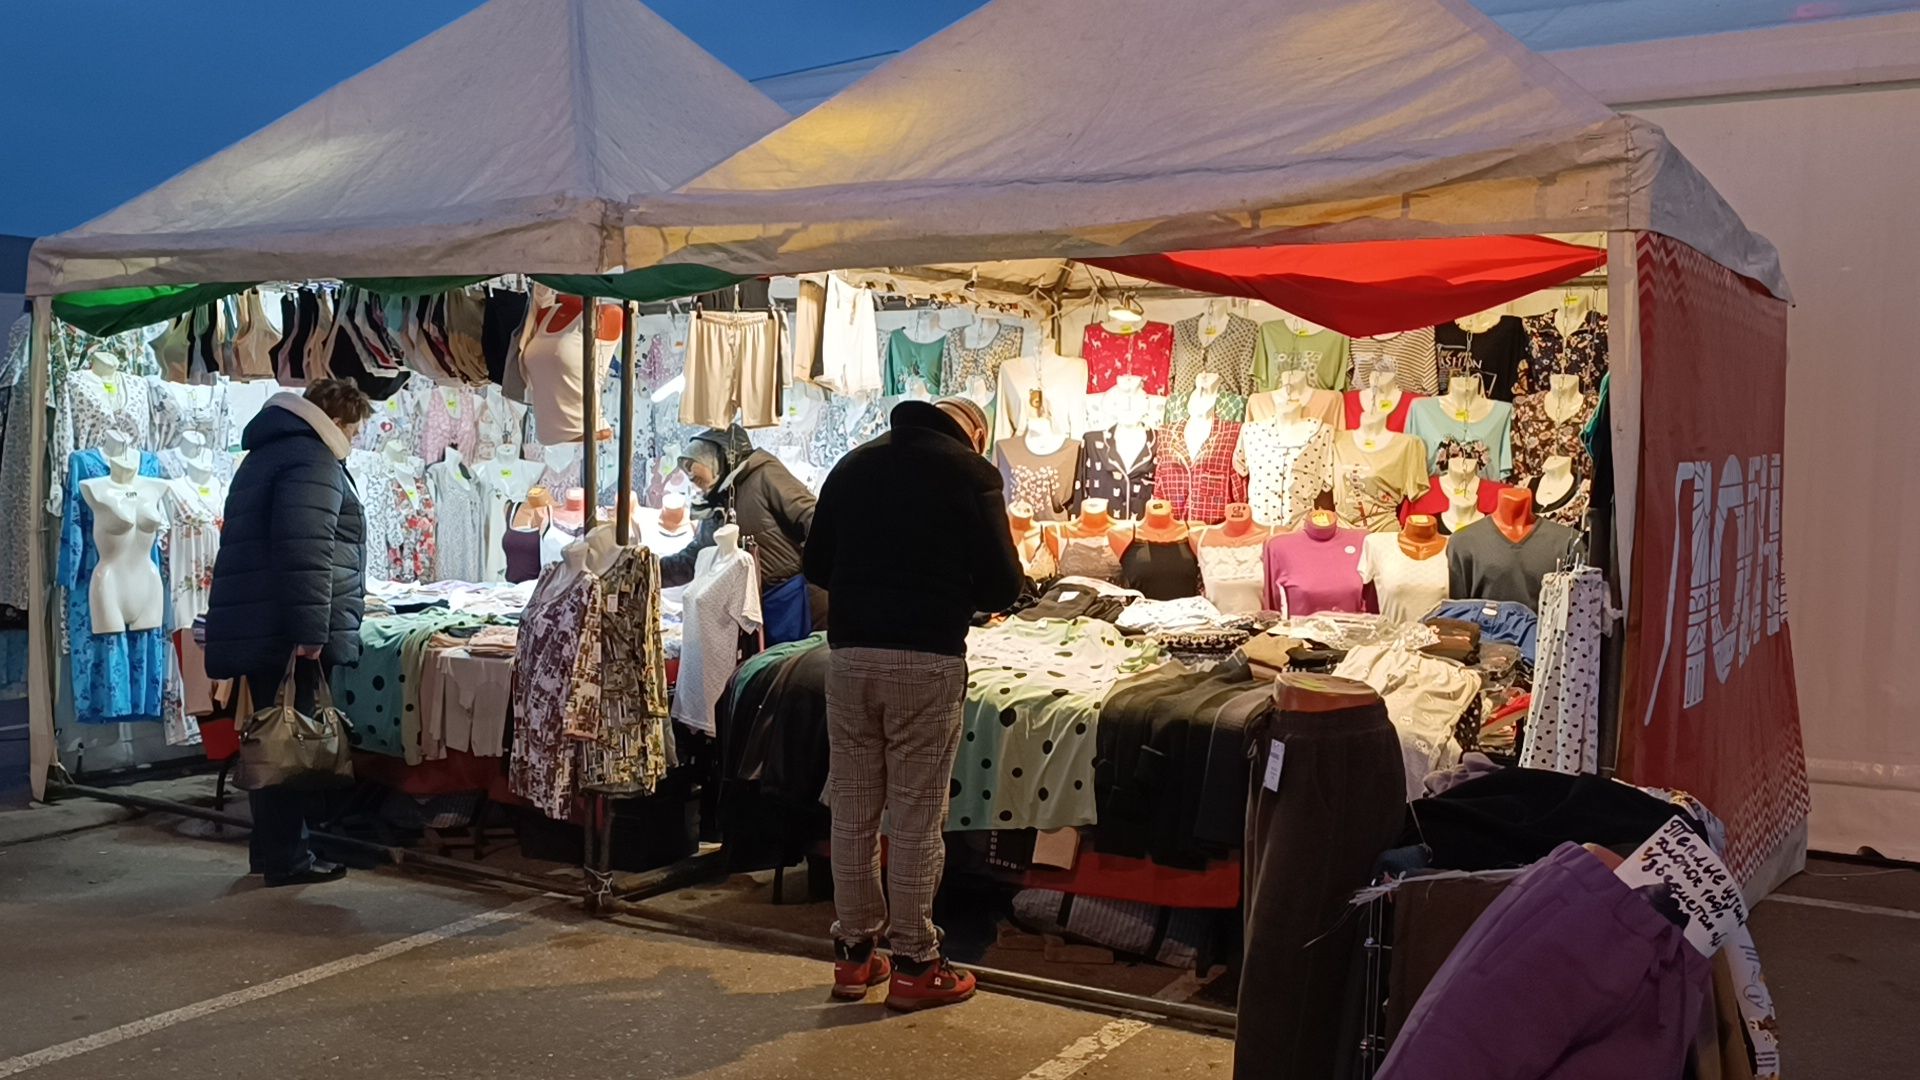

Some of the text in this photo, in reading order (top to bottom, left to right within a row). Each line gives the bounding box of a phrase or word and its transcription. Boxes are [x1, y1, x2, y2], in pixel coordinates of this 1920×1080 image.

[1641, 847, 1714, 932] Узбекистан
[1656, 837, 1703, 888] хлопок
[1663, 820, 1745, 928] Теплые штан
